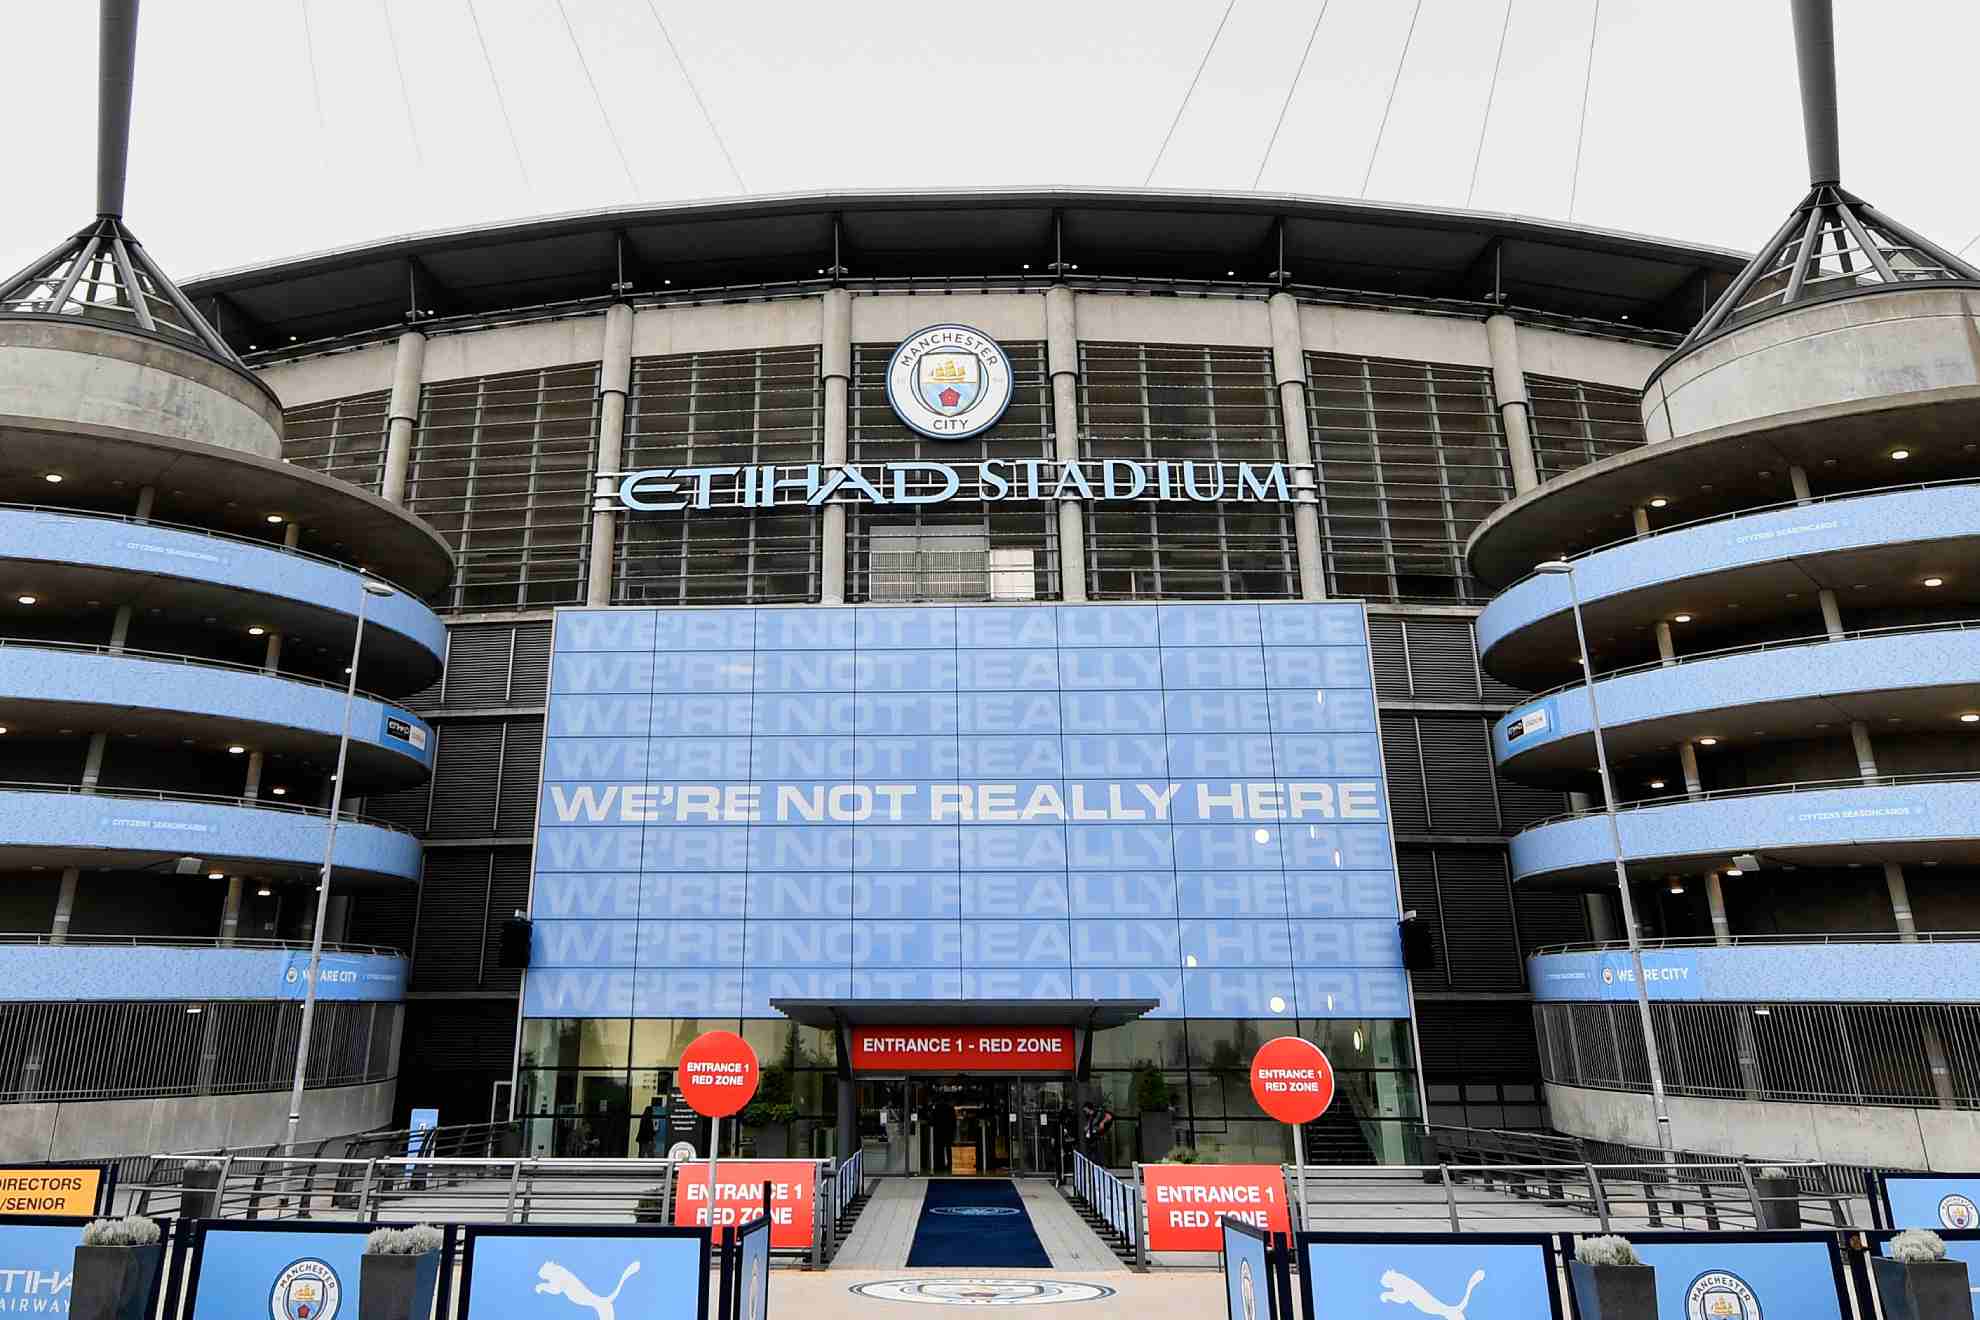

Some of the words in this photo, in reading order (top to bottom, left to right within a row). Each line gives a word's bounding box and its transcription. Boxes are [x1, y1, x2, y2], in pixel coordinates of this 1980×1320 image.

[901, 333, 998, 367] MANCHESTER
[933, 419, 969, 430] CITY
[619, 462, 961, 511] ETIHAD
[978, 459, 1290, 501] STADIUM
[780, 613, 914, 645] NOT
[929, 608, 1166, 645] REALLY
[1184, 606, 1363, 643] HERE
[779, 654, 915, 688] NOT
[929, 651, 1168, 688] REALLY
[1186, 652, 1366, 687] HERE
[779, 697, 915, 731] NOT
[930, 695, 1172, 732] REALLY
[1190, 694, 1370, 729] HERE
[778, 740, 916, 775] NOT
[930, 739, 1175, 775] REALLY
[1194, 738, 1374, 773] HERE
[551, 785, 760, 821] WE'RE
[777, 785, 917, 820] NOT
[930, 784, 1181, 820] REALLY
[1198, 783, 1380, 819] HERE
[776, 830, 914, 866] NOT
[931, 829, 1183, 866] REALLY
[1200, 828, 1384, 866] HERE
[773, 877, 915, 913] NOT
[931, 877, 1185, 913] REALLY
[1204, 875, 1388, 913] HERE
[772, 925, 915, 961] NOT
[932, 924, 1188, 961] REALLY
[1207, 923, 1393, 961] HERE
[320, 969, 339, 982] ARE
[340, 970, 358, 983] CITY
[1616, 967, 1635, 981] WE
[1661, 967, 1689, 981] CITY
[1211, 972, 1397, 1011] HERE
[863, 1038, 950, 1052] ENTRANCE
[955, 1038, 963, 1052] 1
[979, 1038, 1012, 1052] RED
[1017, 1038, 1062, 1052] ZONE
[687, 1062, 742, 1073] ENTRANCE
[743, 1063, 749, 1073] 1
[1258, 1068, 1315, 1079] ENTRANCE
[1316, 1070, 1323, 1079] 1
[691, 1075, 713, 1085] RED
[715, 1075, 744, 1086] ZONE
[1265, 1082, 1287, 1092] RED
[1289, 1082, 1319, 1092] ZONE
[794, 1183, 802, 1200] 1
[1156, 1185, 1260, 1203] ENTRANCE
[1265, 1186, 1275, 1203] 1
[0, 1197, 65, 1211] /SENIOR
[696, 1207, 735, 1225] RED
[1169, 1210, 1209, 1228] RED
[0, 1269, 73, 1295] TIHA
[280, 1264, 335, 1288] MANCHESTER
[1692, 1276, 1751, 1302] MANCHESTER
[0, 1298, 70, 1313] AIRWAY
